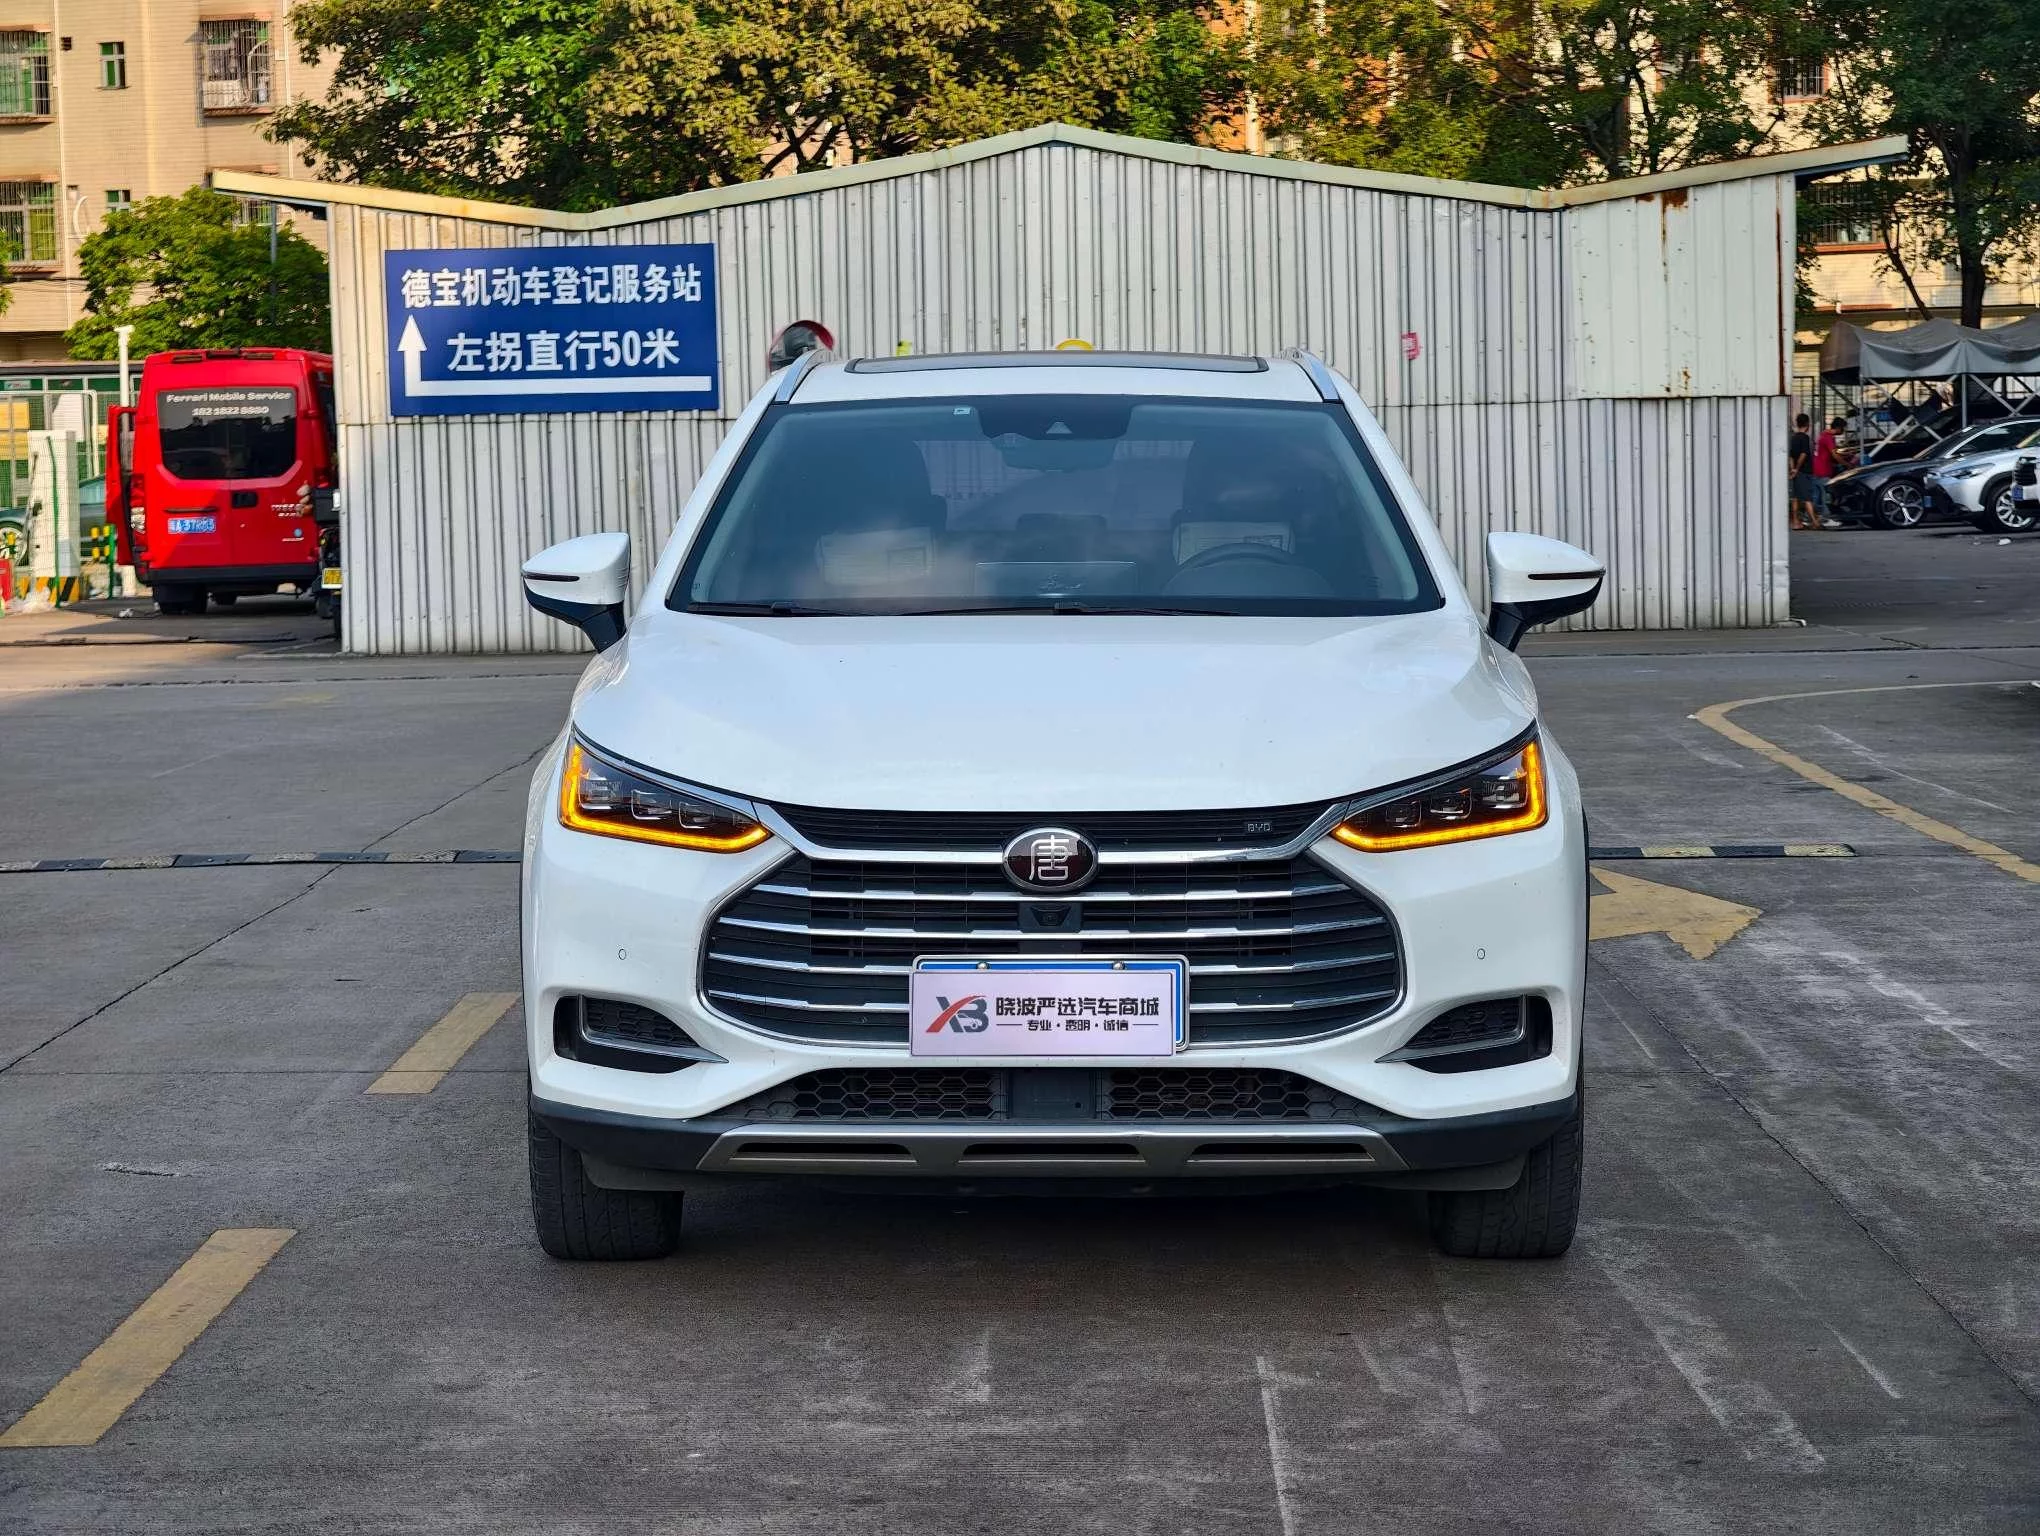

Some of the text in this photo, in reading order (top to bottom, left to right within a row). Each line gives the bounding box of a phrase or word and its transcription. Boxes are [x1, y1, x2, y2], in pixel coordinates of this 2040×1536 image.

[401, 263, 701, 309] 德宝机动车登记服务站
[446, 327, 681, 372] 左拐直行50米
[166, 391, 291, 403] Ferrari Mobile Service
[1247, 823, 1271, 832] BYD
[1028, 834, 1075, 881] 唐
[995, 997, 1159, 1016] 晓波严选汽车商城
